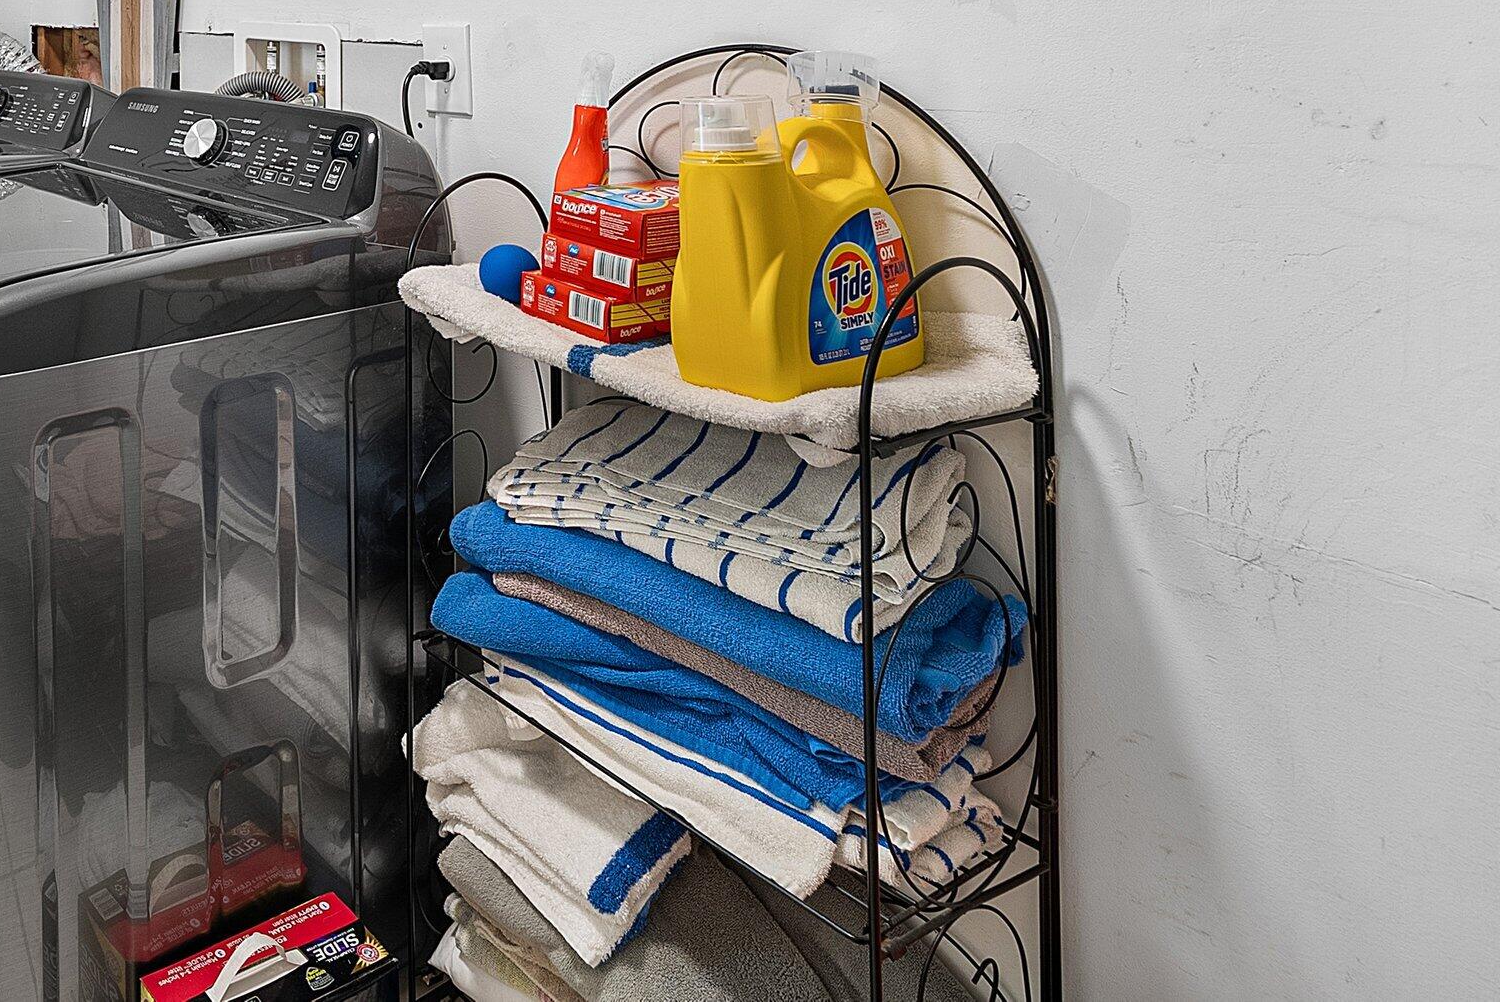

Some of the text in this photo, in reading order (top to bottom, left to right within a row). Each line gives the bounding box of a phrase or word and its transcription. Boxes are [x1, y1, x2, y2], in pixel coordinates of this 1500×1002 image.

[127, 101, 159, 114] SAMSUNG
[562, 199, 597, 214] bounce
[874, 219, 887, 230] 99%
[880, 244, 895, 261] OXI
[884, 261, 906, 279] STAIN
[645, 284, 666, 296] bounce
[829, 261, 872, 315] Tide
[841, 312, 874, 329] SIMPLY
[620, 326, 641, 337] bounce
[298, 904, 319, 916] EMPTY
[308, 908, 323, 918] Start
[272, 919, 284, 927] pan
[313, 933, 359, 962] SLIDE
[190, 956, 218, 971] Maintain
[167, 966, 184, 975] litter
[180, 969, 192, 977] 3-4
[158, 974, 180, 986] inches
